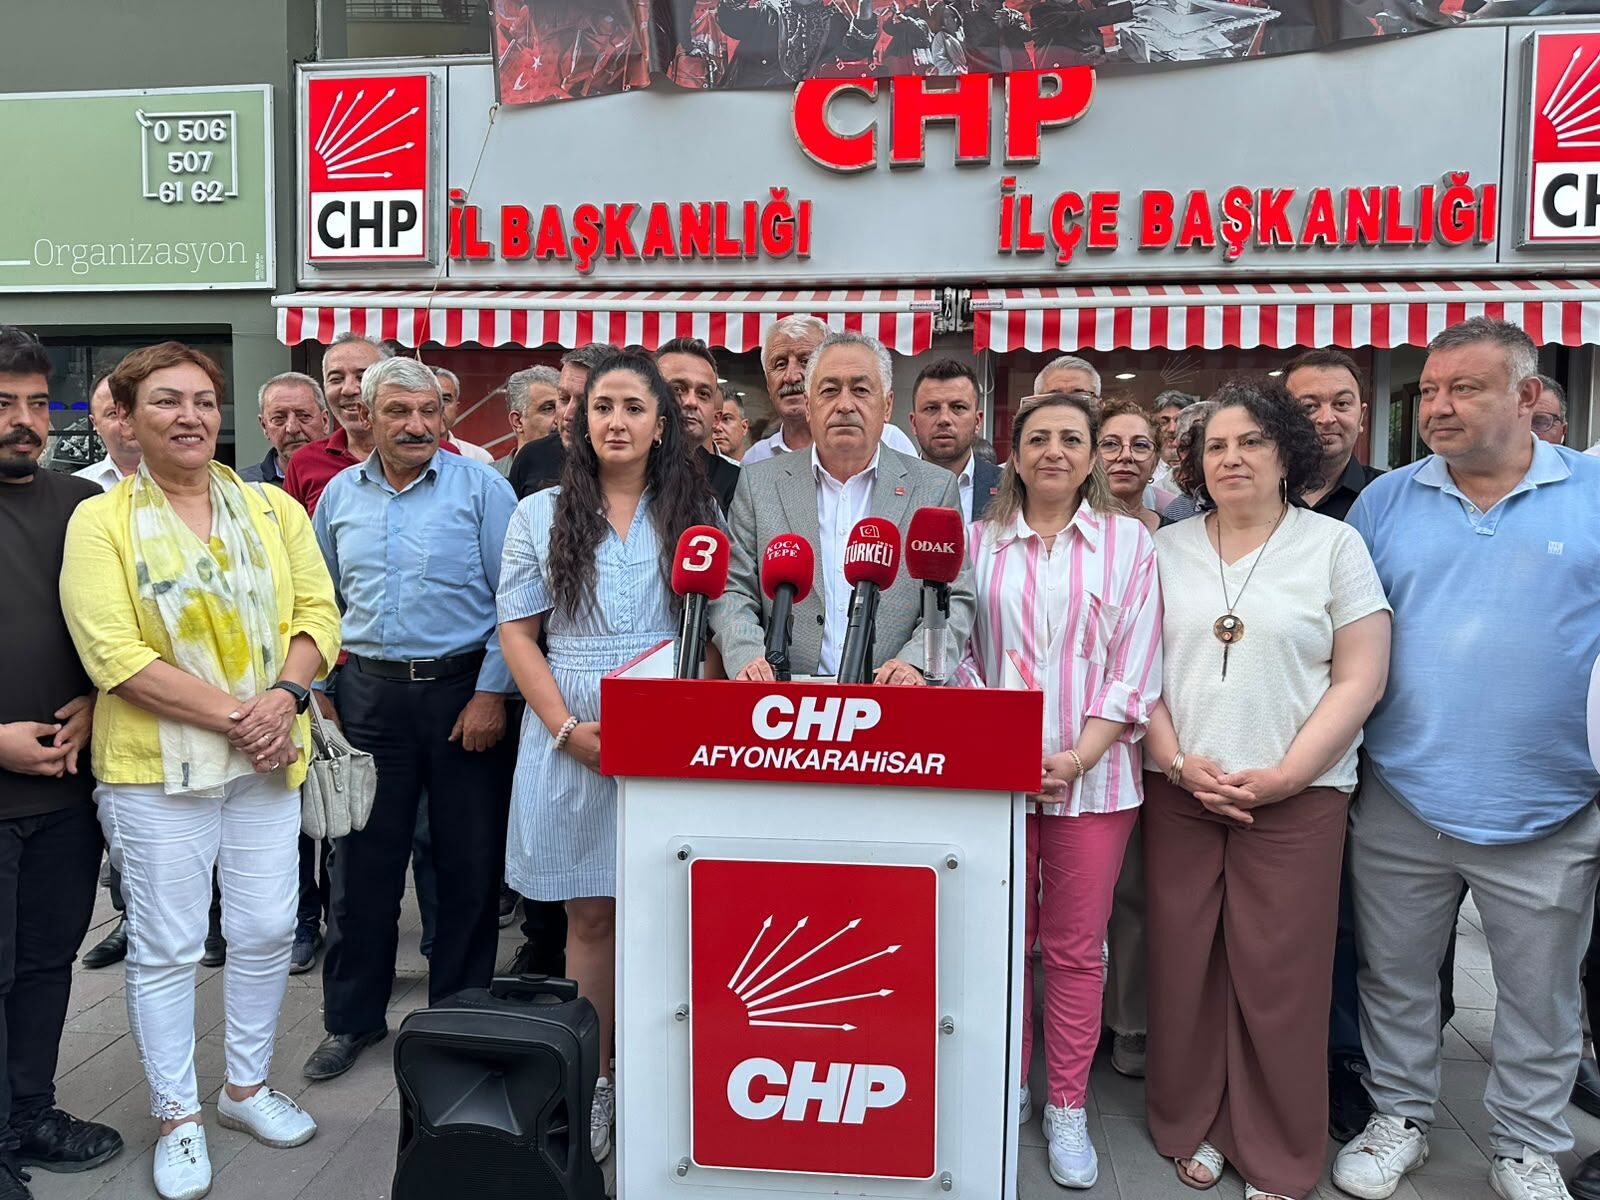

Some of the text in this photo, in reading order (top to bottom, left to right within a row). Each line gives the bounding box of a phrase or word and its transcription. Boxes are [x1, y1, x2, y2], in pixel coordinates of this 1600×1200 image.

[154, 119, 227, 143] 0 506
[791, 65, 1097, 173] CHP
[168, 150, 214, 173] 507
[159, 180, 225, 204] 61 62
[317, 199, 418, 249] CHP
[449, 186, 813, 274] İL BAŞKANLIĞI
[998, 171, 1497, 265] İLÇE BAŞKANLIĞI
[33, 237, 249, 275] Organizasyon
[681, 535, 718, 572] 3
[766, 540, 801, 555] KOCA
[767, 549, 798, 561] TEPE
[911, 540, 956, 554] ODAK
[751, 694, 881, 742] CHP
[726, 1057, 907, 1124] CHP
